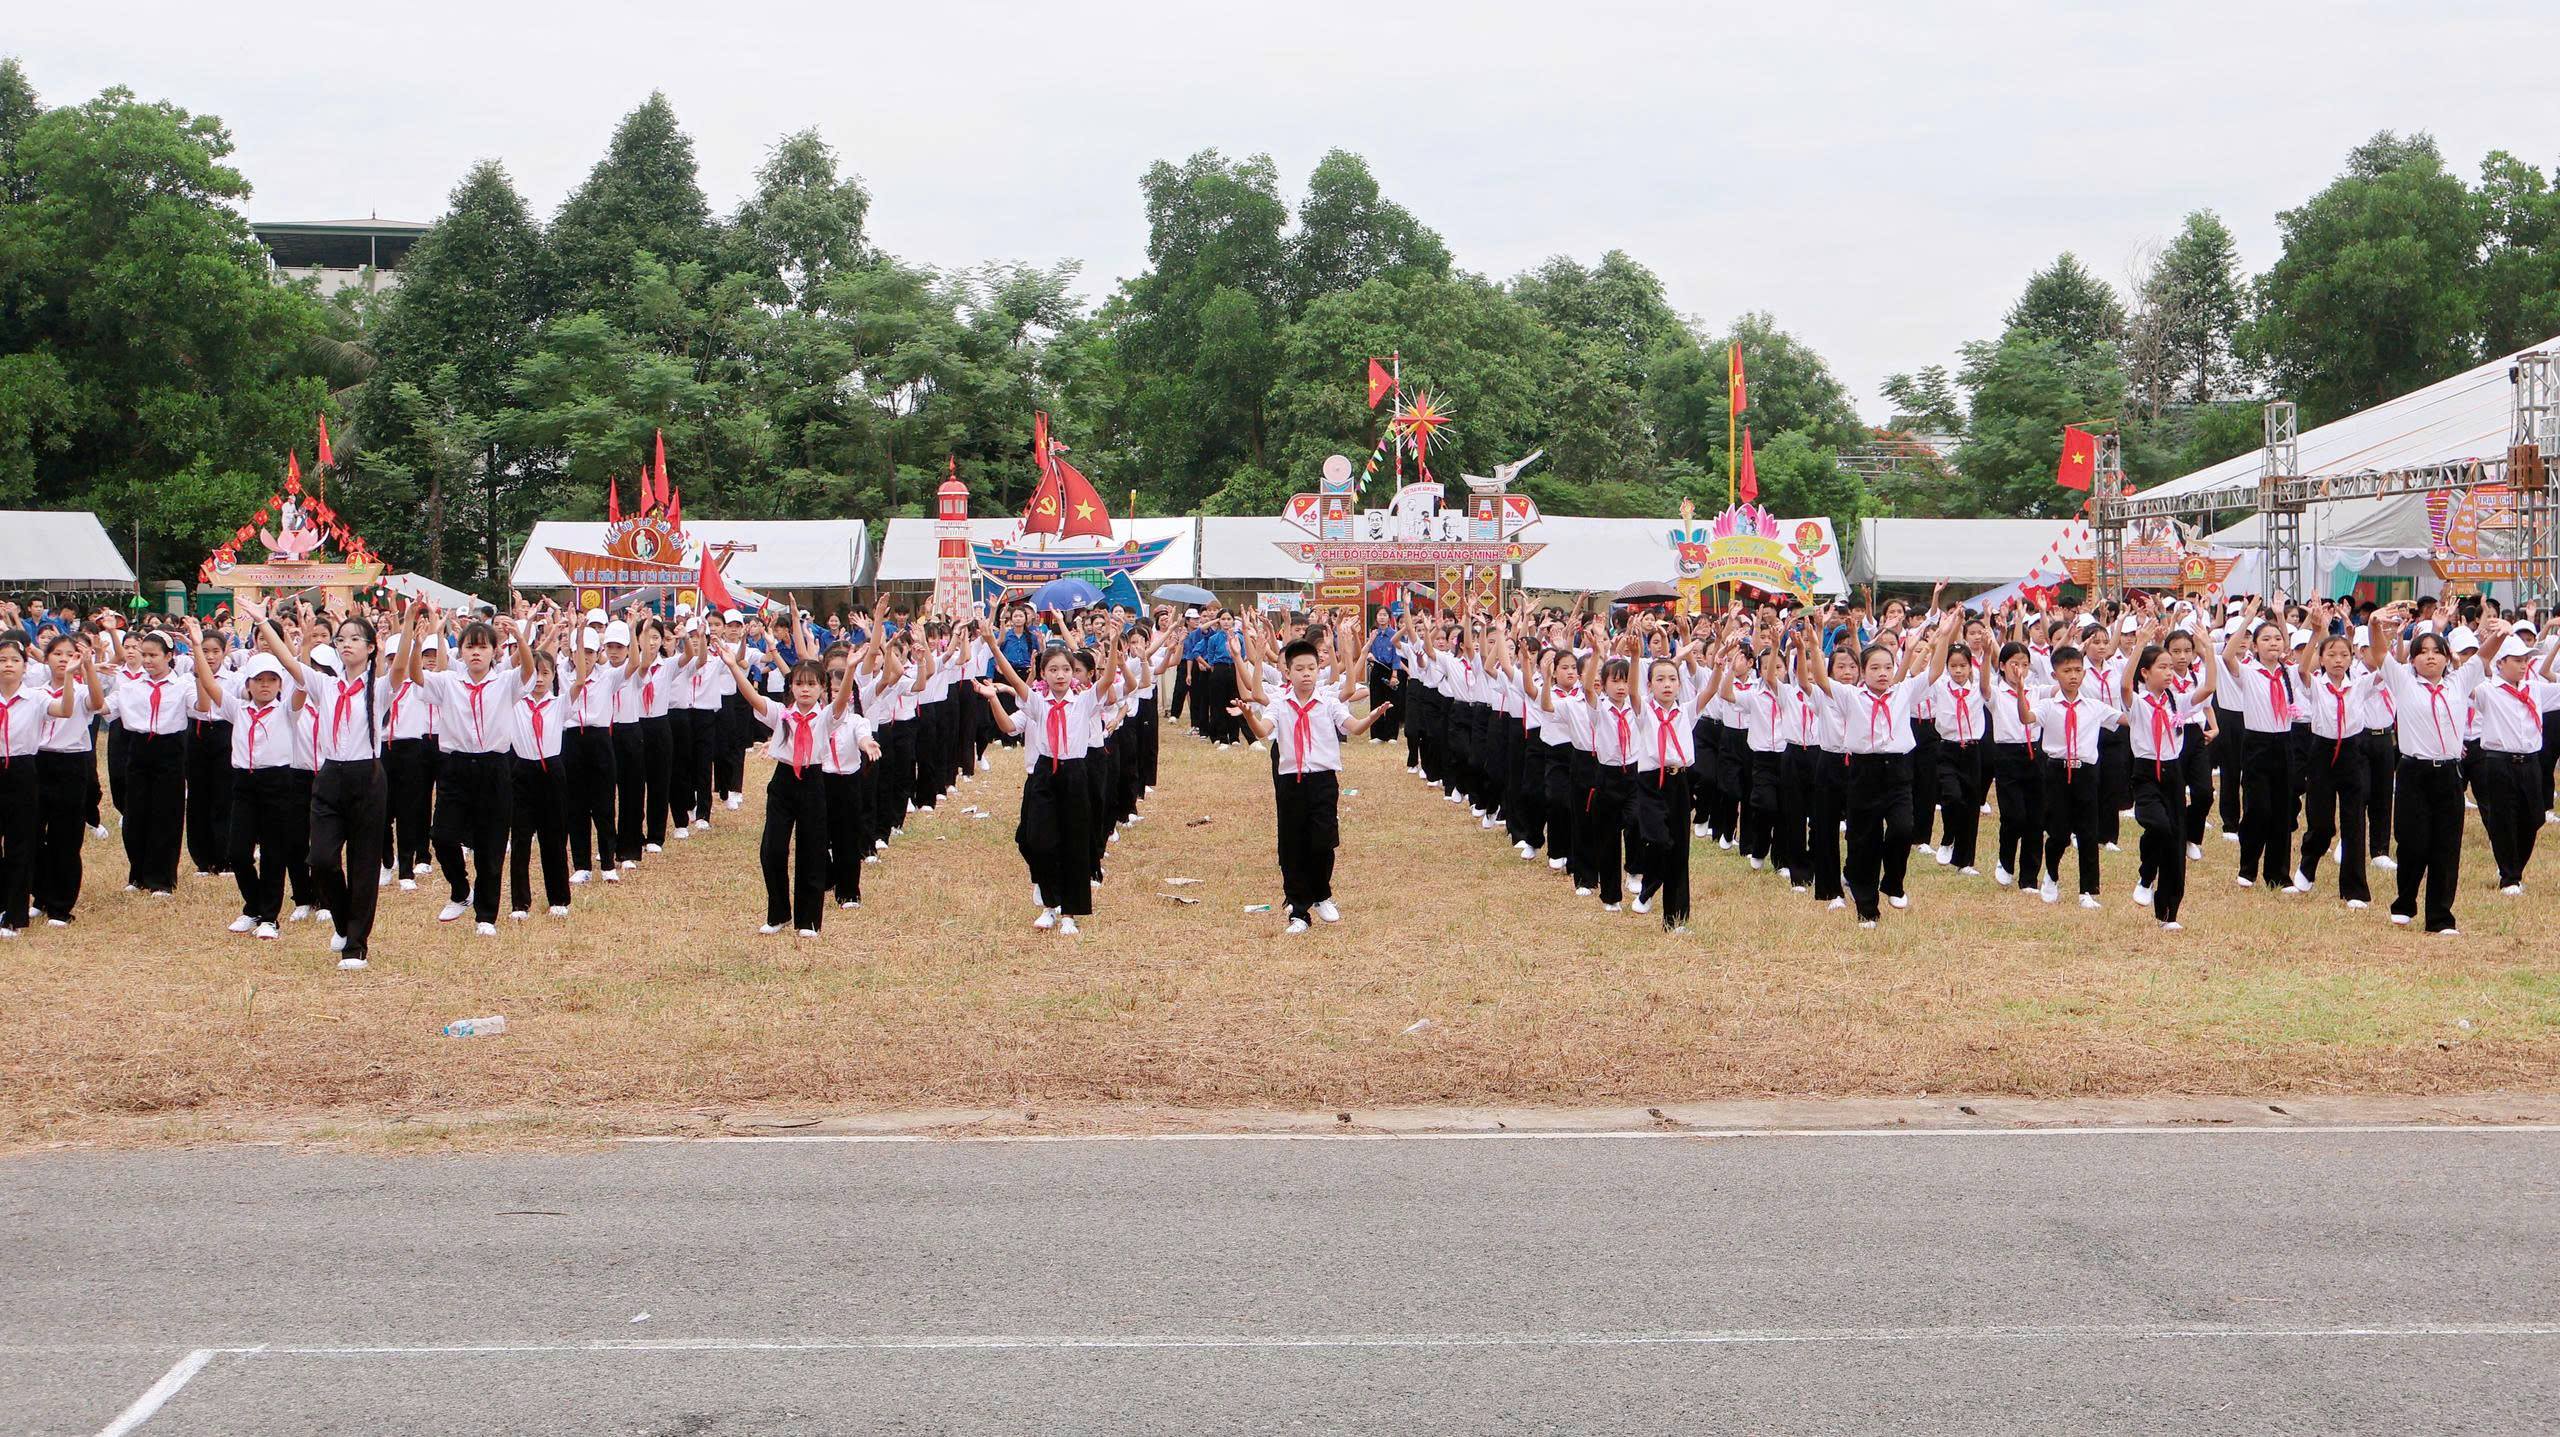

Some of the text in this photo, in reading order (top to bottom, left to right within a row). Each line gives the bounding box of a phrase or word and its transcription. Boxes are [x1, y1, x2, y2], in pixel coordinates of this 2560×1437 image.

[1321, 550, 1339, 558] CHI
[1382, 548, 1403, 558] DÂN
[1407, 546, 1428, 558] PHỐ
[1472, 550, 1498, 558] MINH
